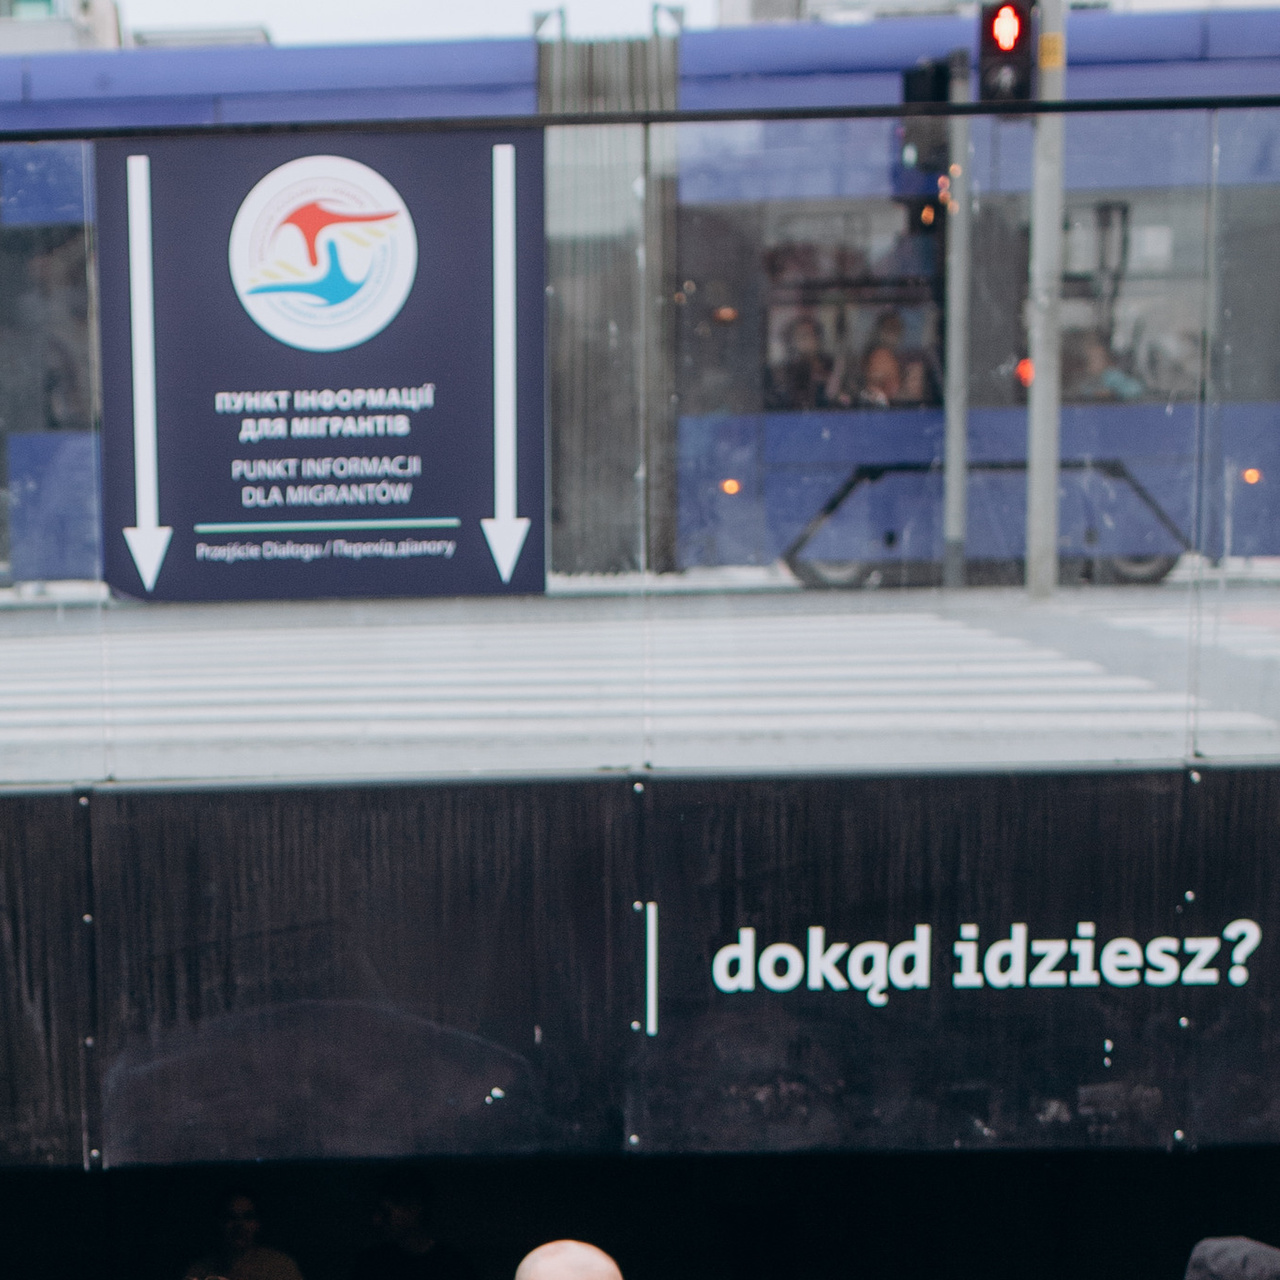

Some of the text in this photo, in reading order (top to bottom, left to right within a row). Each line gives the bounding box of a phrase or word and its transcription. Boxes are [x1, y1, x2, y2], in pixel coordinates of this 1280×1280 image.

[215, 383, 436, 414] ПУНКТ ІНФОРМАЦІЇ
[239, 414, 411, 443] ДЛЯ МІГРАНТІВ
[232, 455, 422, 480] PUNKT INFORMACJI
[242, 479, 413, 508] DLA MIGRANTÓW
[262, 540, 322, 562] Dialogu
[712, 918, 1263, 1007] dokąd idziesz?
